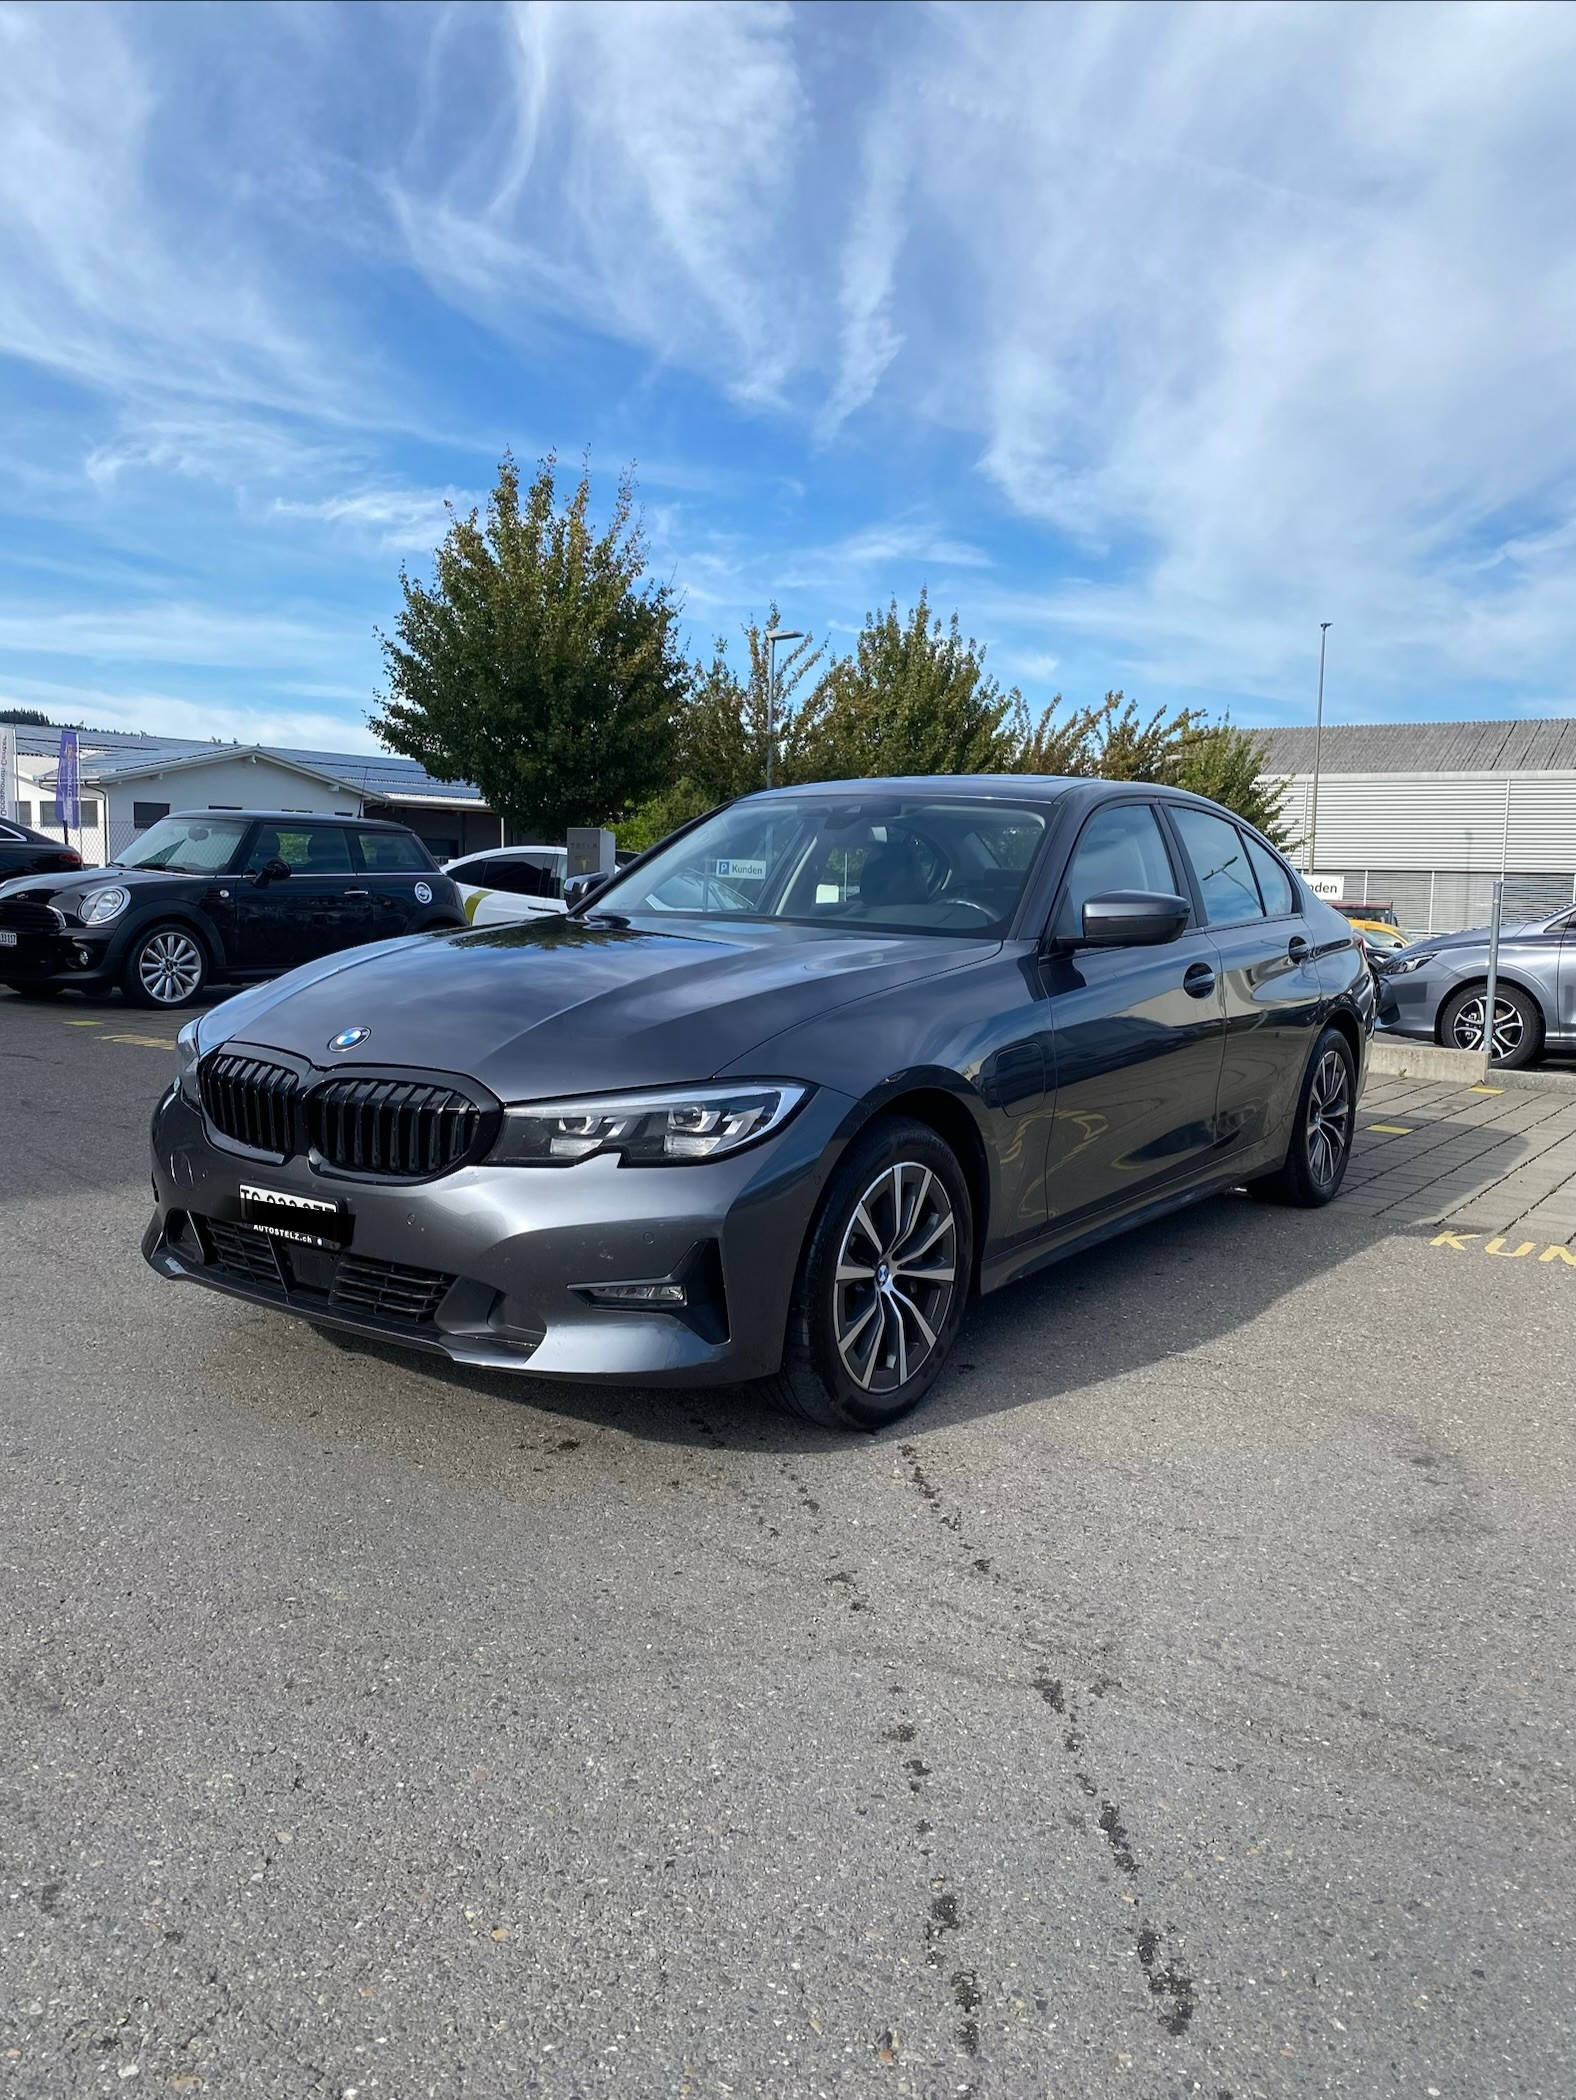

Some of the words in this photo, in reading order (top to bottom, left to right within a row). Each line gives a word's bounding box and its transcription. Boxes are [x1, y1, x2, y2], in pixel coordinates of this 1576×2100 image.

[731, 864, 763, 874] Kunden
[1308, 882, 1338, 893] nden
[0, 934, 16, 944] 33117
[253, 1224, 312, 1244] AUTOSTELZ.ch
